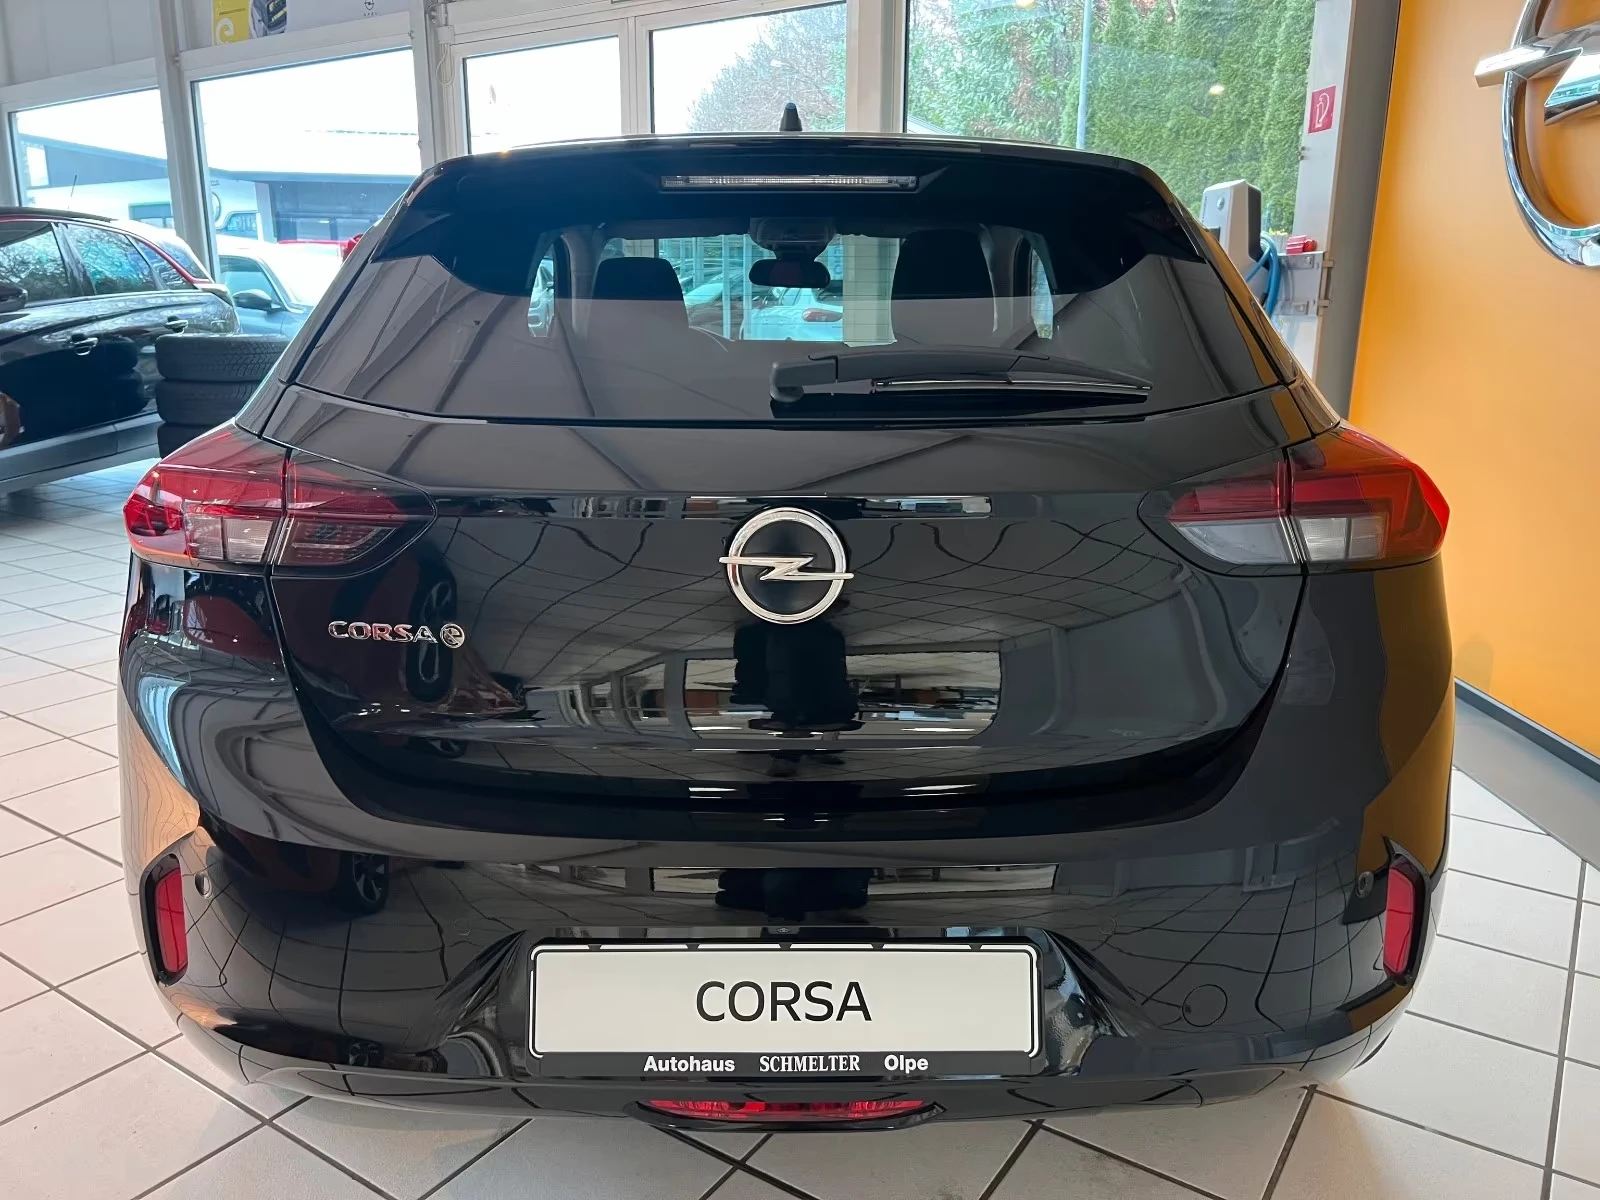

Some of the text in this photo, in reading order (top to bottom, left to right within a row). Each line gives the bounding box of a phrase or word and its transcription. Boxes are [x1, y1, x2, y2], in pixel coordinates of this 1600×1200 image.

[328, 620, 438, 644] CORSA
[696, 980, 872, 1022] CORSA
[643, 1054, 929, 1074] Autohaus SCHMELTER Olpe
